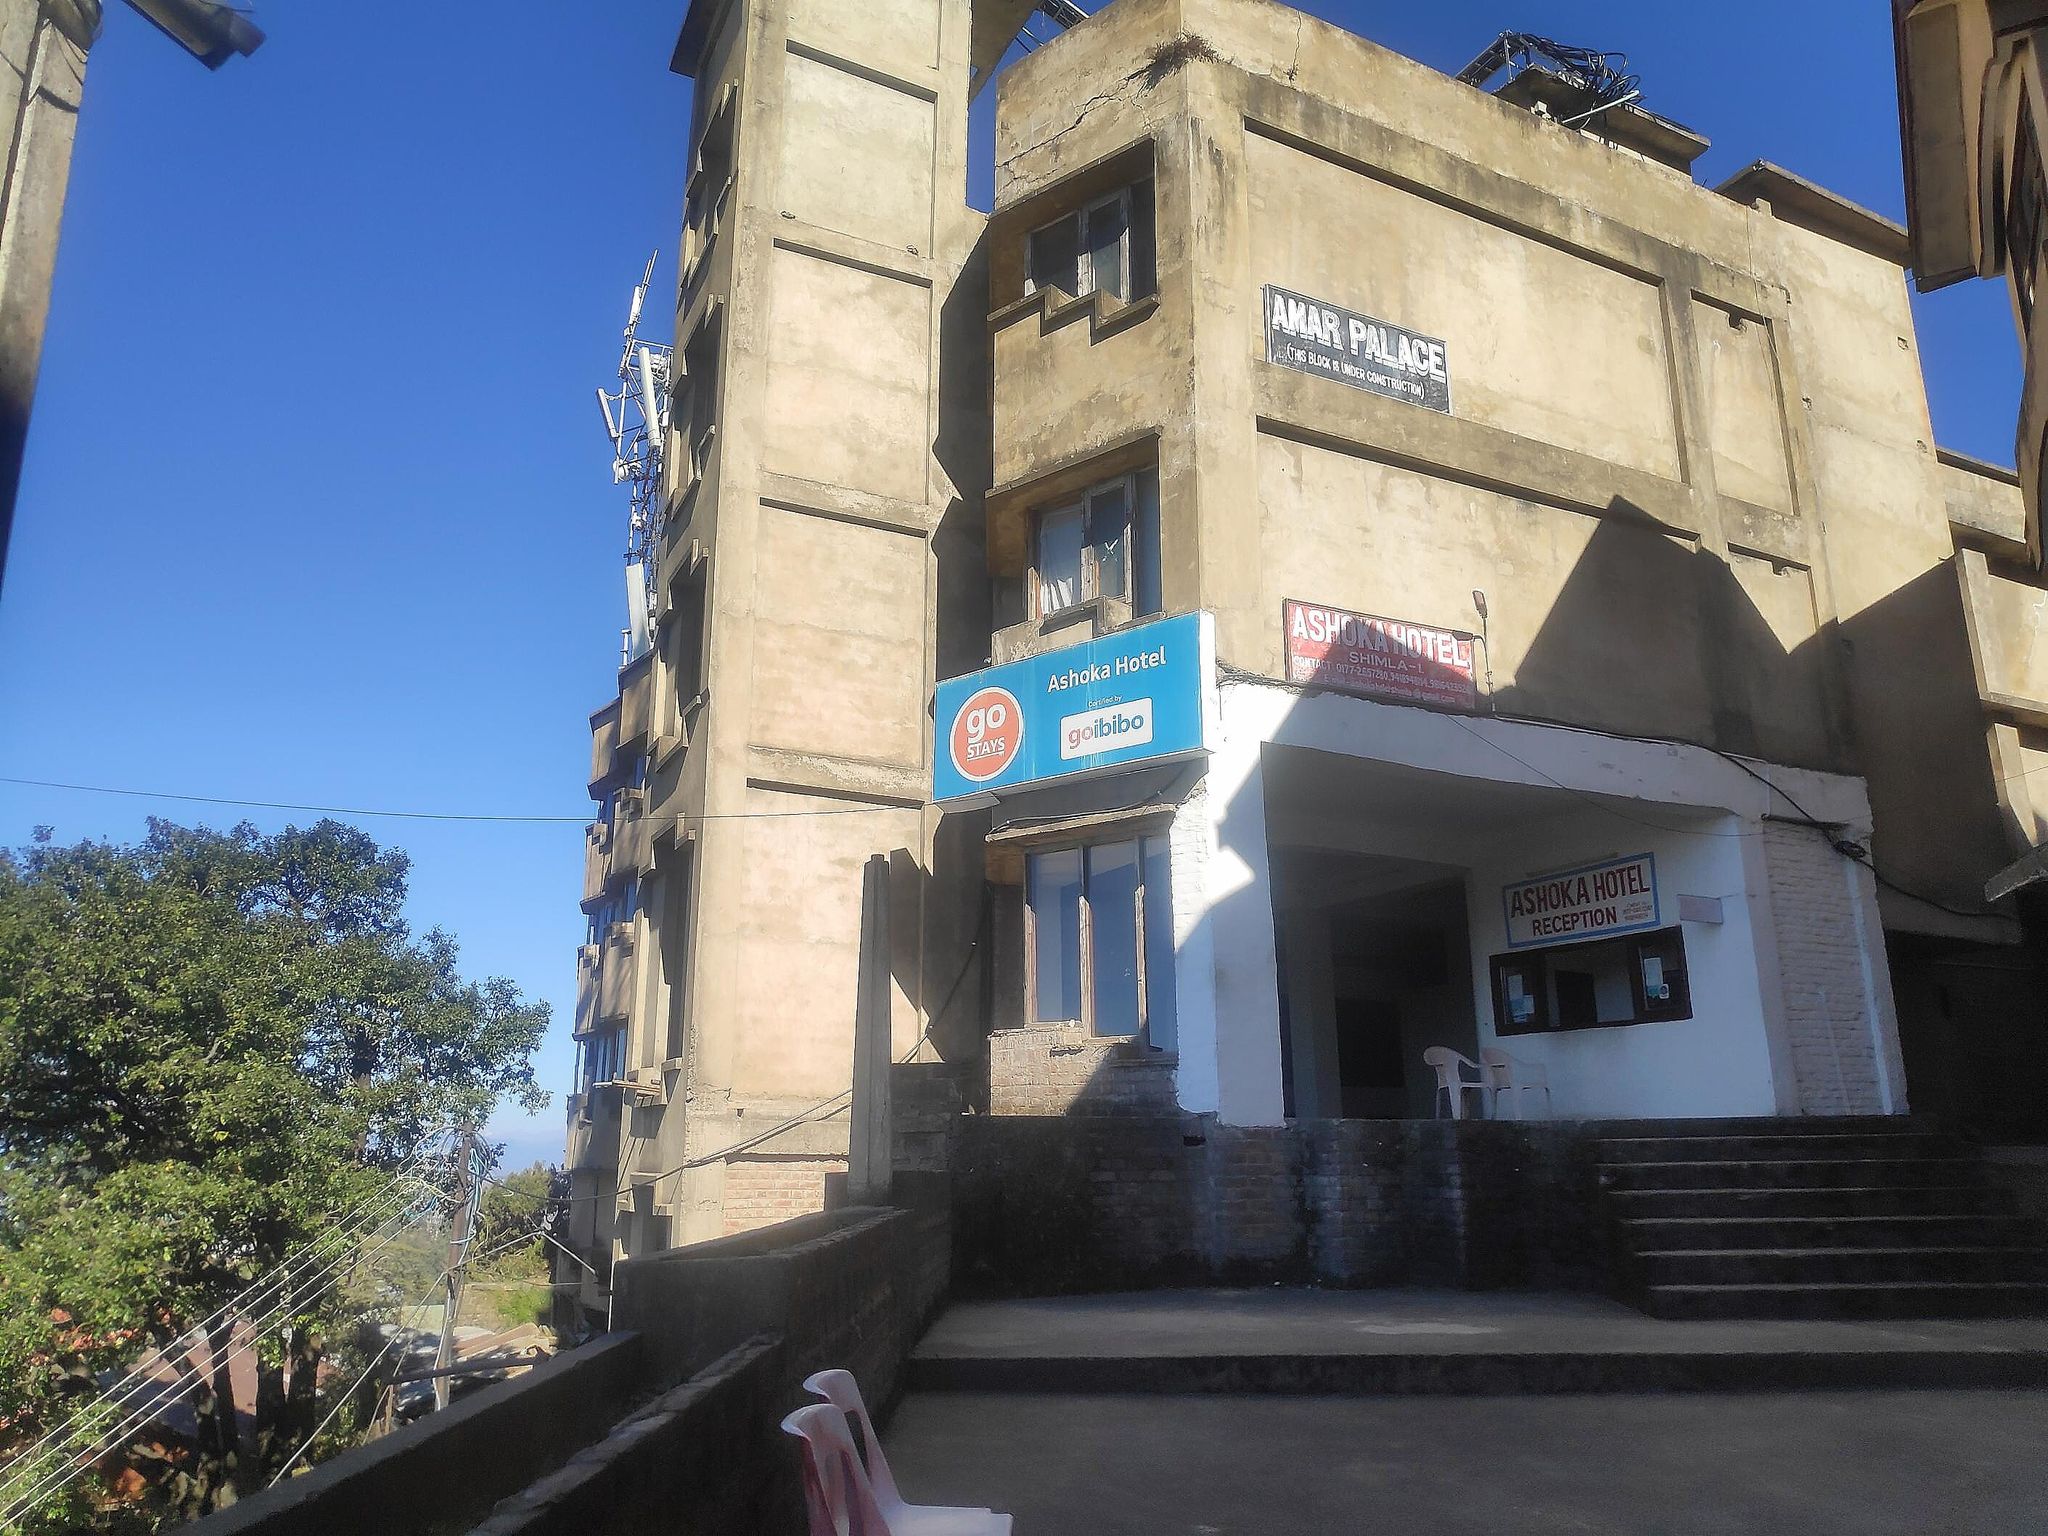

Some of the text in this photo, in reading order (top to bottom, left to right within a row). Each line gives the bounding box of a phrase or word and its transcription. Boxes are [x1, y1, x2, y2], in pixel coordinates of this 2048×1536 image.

[1271, 293, 1446, 384] AMAR PALACE
[1286, 342, 1425, 400] (THIS BLOCK IS UNDER CONSTRUCTION)
[1292, 605, 1471, 669] ASHOKA HOTEL
[1047, 646, 1166, 693] Ashoka Hotel
[966, 702, 1006, 743] go
[1069, 713, 1144, 750] goibibo
[967, 737, 1005, 759] STAYS
[1510, 876, 1590, 918] ASHOKA
[1593, 864, 1650, 902] HOTEL
[1532, 906, 1617, 936] RECEPTION
